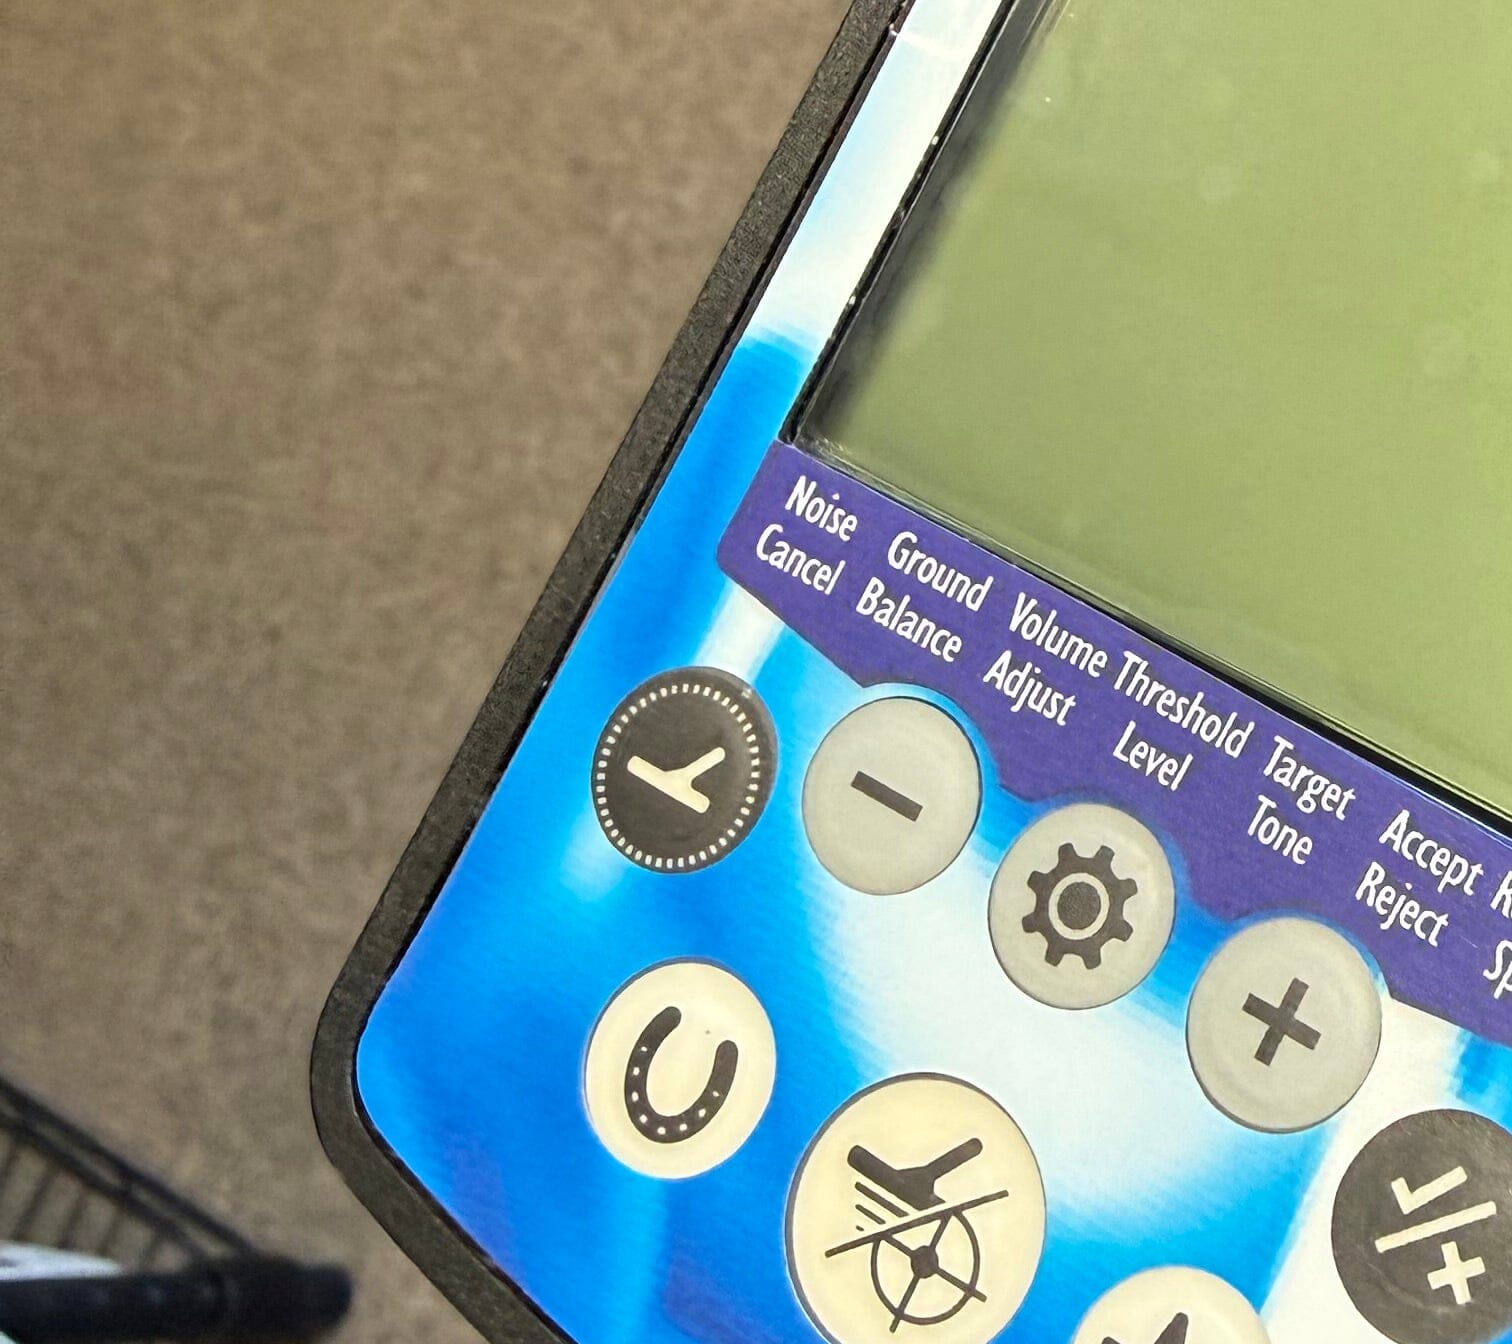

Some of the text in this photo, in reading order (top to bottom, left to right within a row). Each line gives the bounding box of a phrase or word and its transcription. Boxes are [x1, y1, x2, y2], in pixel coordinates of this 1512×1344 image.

[785, 476, 857, 543] Noise
[757, 524, 845, 594] Cancel
[887, 532, 993, 611] Ground
[856, 578, 962, 662] Balance
[1009, 594, 1108, 678] Volume
[984, 650, 1075, 726] Adjust
[1114, 653, 1254, 757] Threshold
[1114, 723, 1193, 791] Level
[1265, 736, 1355, 821] Target
[1248, 795, 1313, 865] Tone
[1382, 810, 1484, 896] Accept
[1356, 862, 1450, 947] Reject
